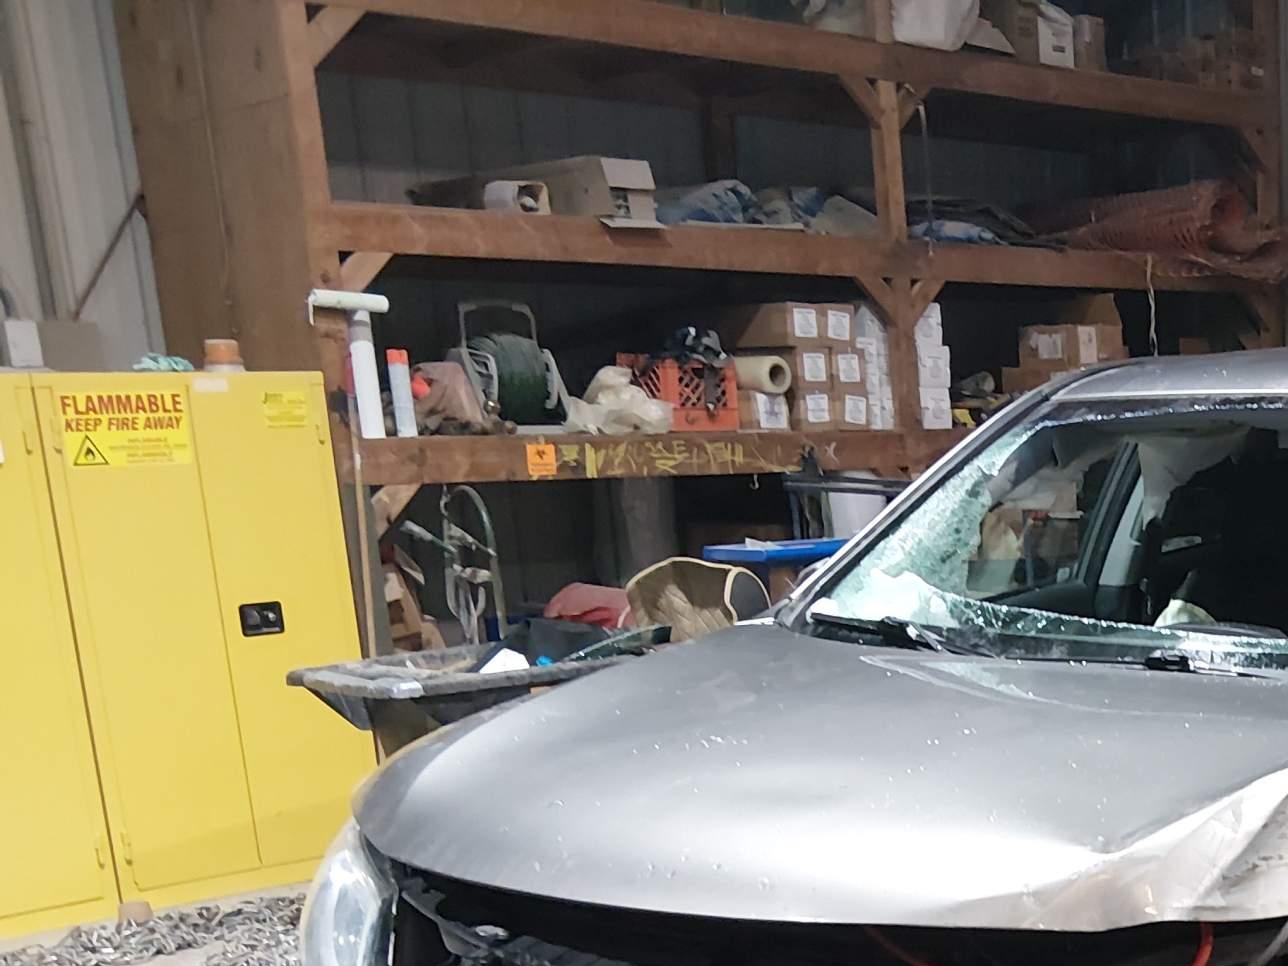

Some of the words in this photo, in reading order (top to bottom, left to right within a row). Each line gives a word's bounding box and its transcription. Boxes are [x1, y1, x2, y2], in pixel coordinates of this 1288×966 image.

[60, 393, 183, 416] FLAMMABLE
[65, 418, 102, 433] KEEP
[107, 416, 140, 431] FIRE
[143, 415, 182, 430] AWAY
